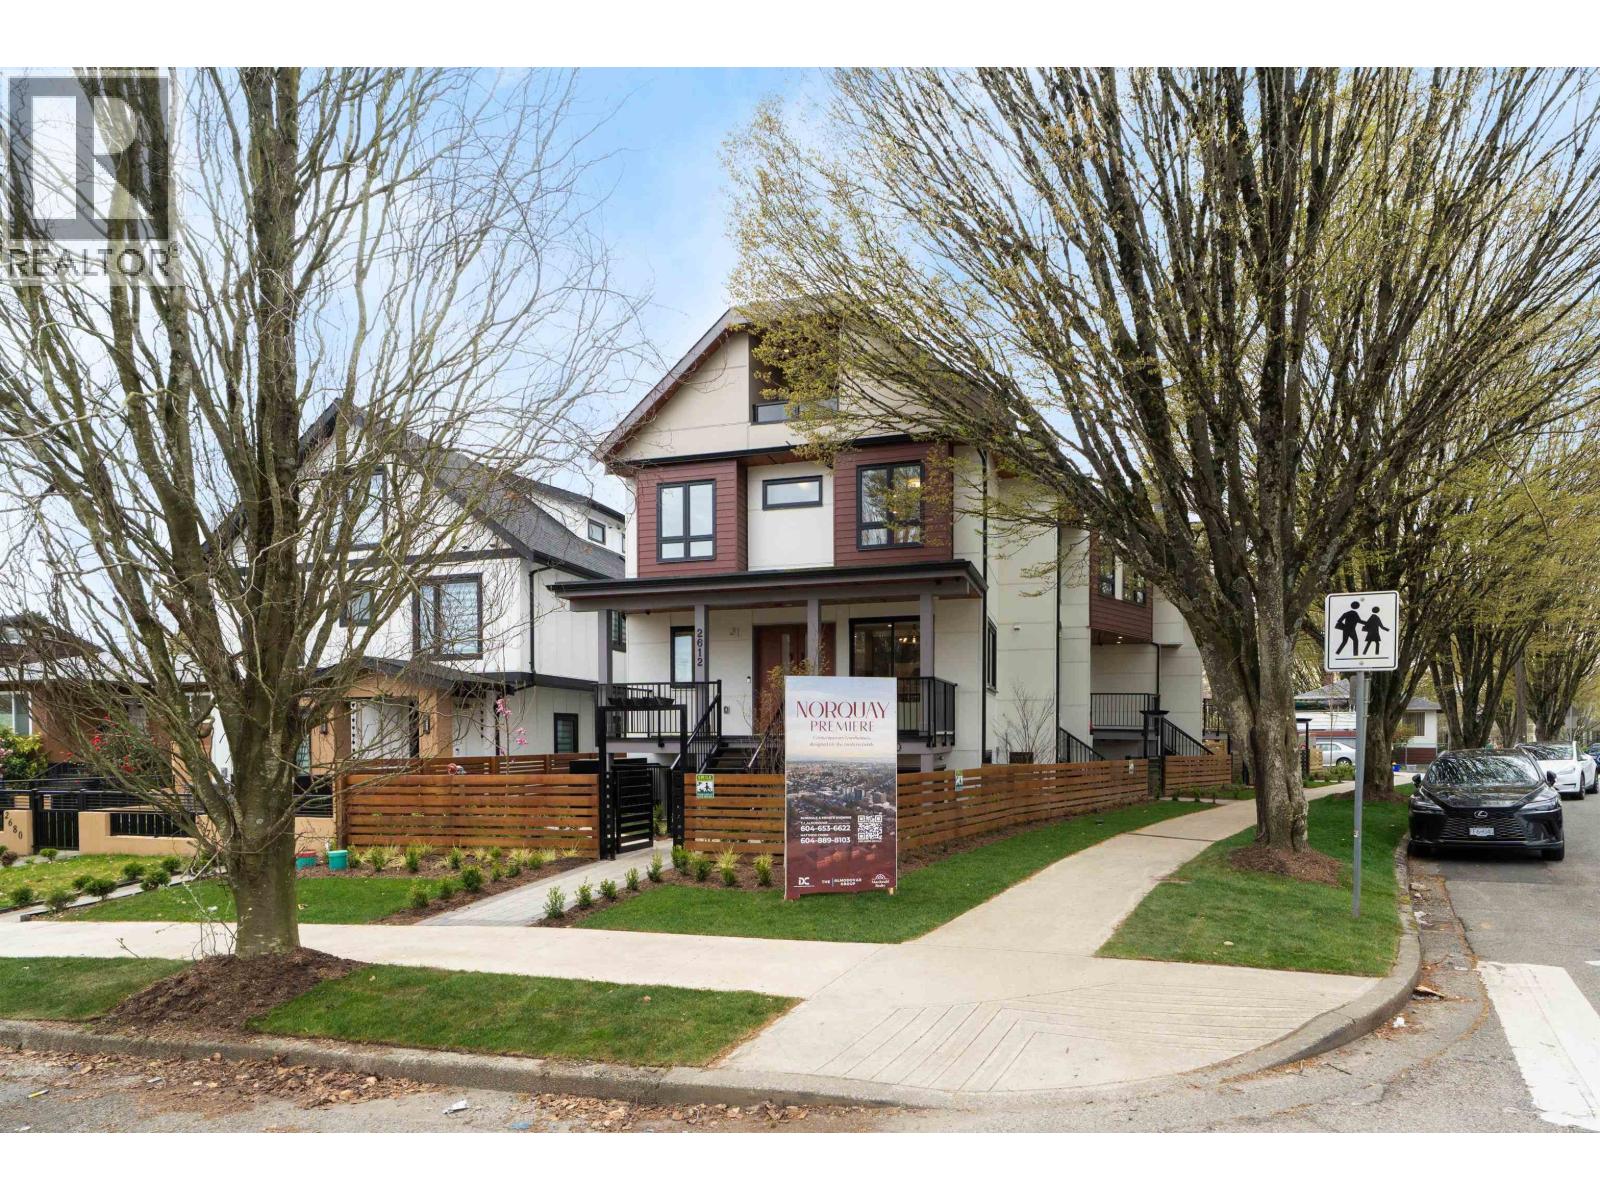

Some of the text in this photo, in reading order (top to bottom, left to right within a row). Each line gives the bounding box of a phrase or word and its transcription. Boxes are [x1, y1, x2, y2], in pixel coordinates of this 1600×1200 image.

[796, 701, 890, 719] NORQUAY
[810, 721, 874, 732] PREMIERE
[798, 877, 810, 886] DC
